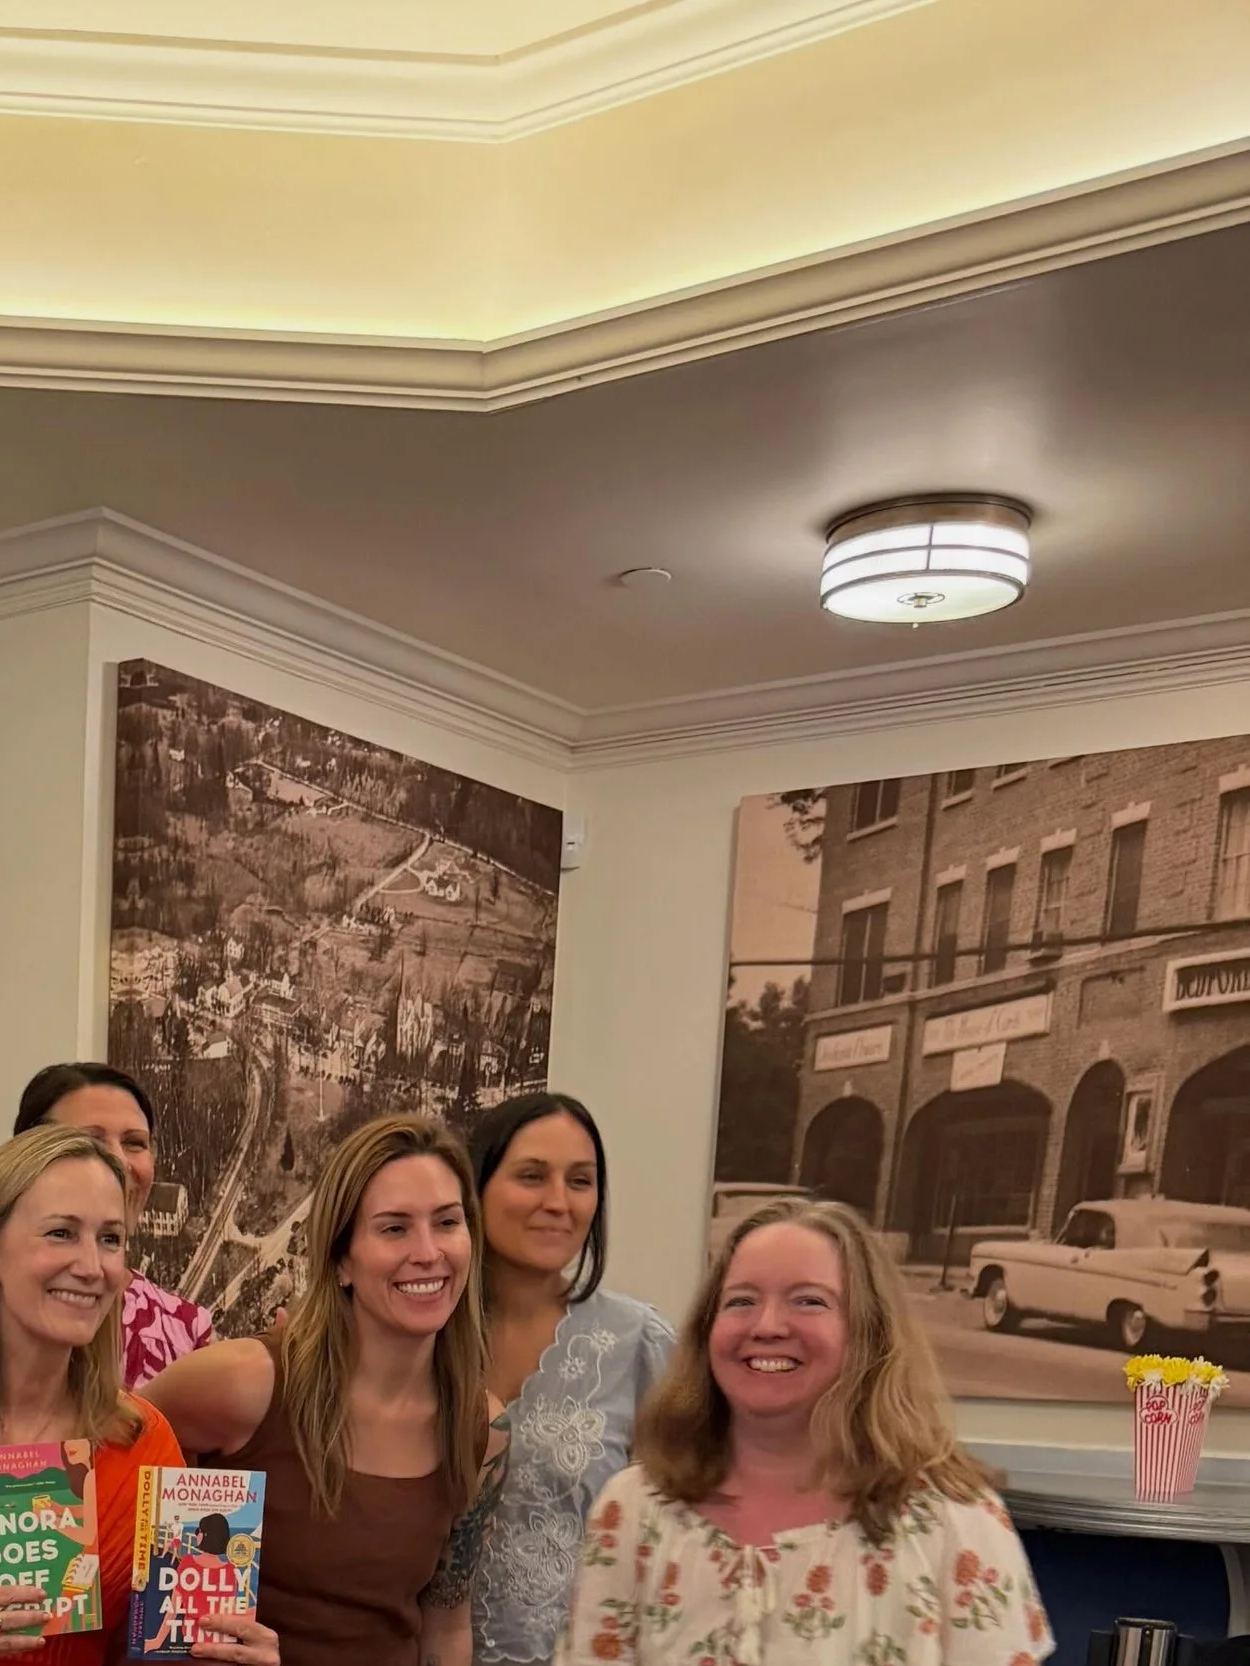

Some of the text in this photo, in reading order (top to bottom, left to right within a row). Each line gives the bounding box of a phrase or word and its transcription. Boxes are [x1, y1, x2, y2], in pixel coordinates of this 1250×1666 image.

[1146, 1400, 1166, 1411] POP
[1145, 1412, 1172, 1424] CORN
[176, 1474, 247, 1488] ANNABEL
[142, 1471, 151, 1516] DOLLY
[162, 1488, 257, 1503] MONAGHAN
[138, 1535, 147, 1570] TIME
[158, 1567, 251, 1591] DOLLY
[159, 1595, 247, 1614] ALL THE
